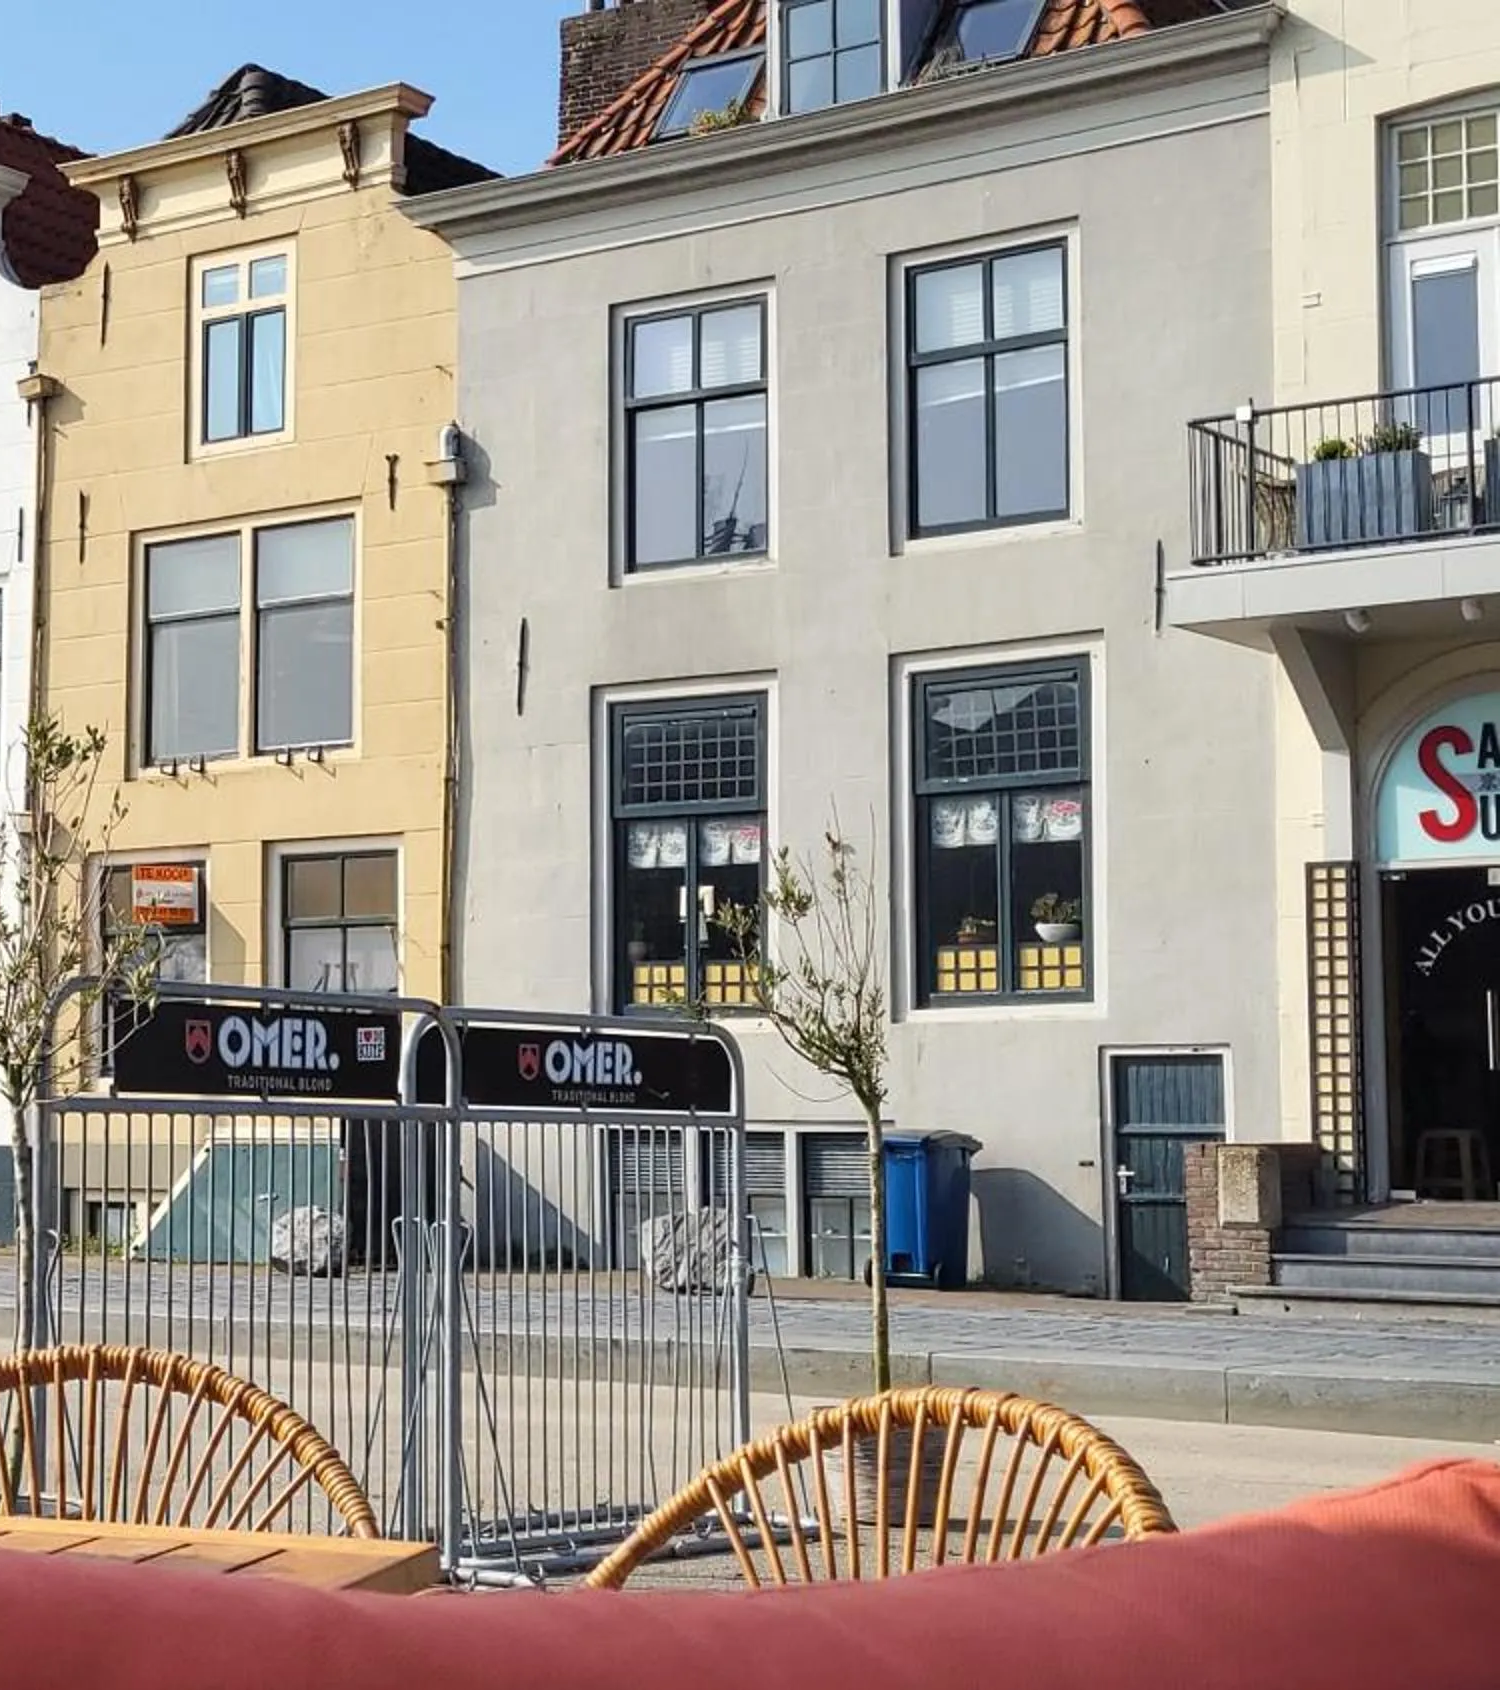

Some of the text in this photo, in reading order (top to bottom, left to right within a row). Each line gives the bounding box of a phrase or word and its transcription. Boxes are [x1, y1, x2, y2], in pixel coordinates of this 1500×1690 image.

[1414, 899, 1500, 976] ALL YOU
[217, 1015, 341, 1070] OMER.
[544, 1039, 643, 1085] OMER.
[227, 1074, 333, 1091] TRADITIONAL BLOND
[551, 1088, 607, 1102] TRADITIONAL
